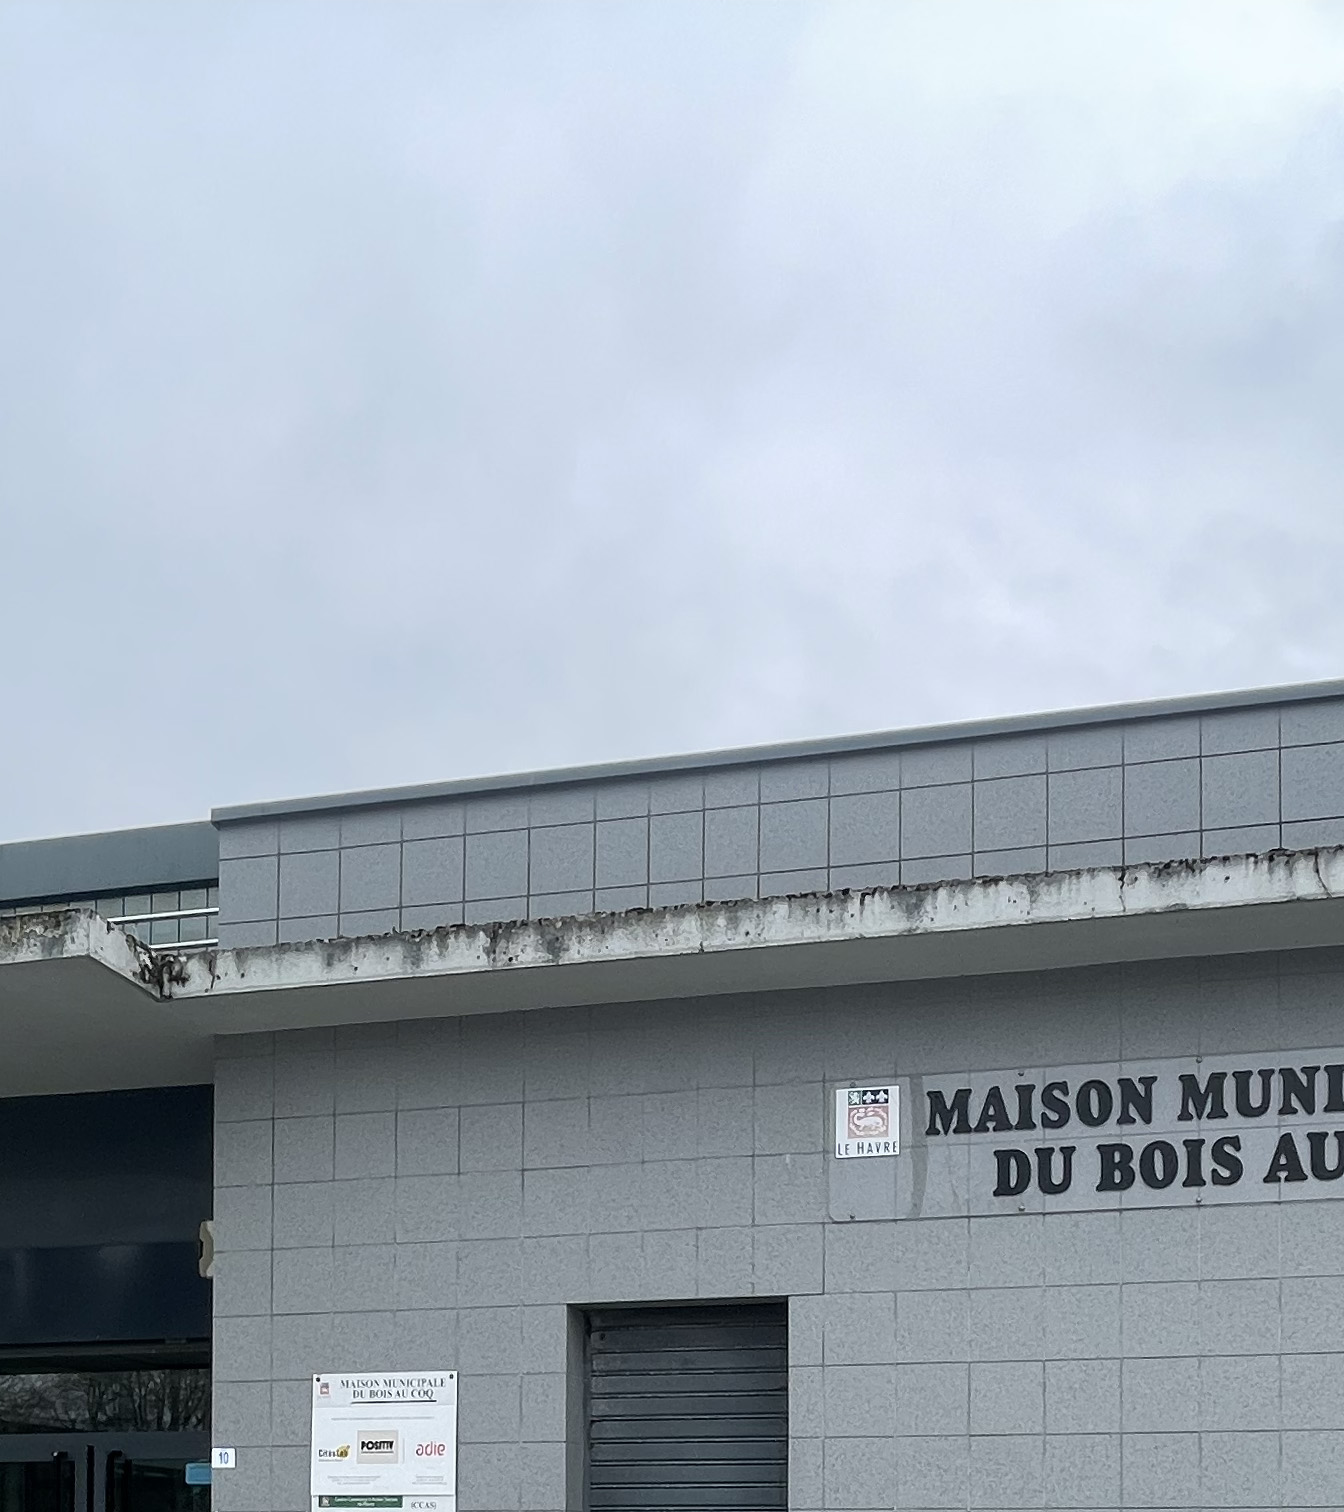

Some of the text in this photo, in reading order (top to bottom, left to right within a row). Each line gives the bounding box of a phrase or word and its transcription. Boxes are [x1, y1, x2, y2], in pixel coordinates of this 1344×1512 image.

[925, 1076, 1158, 1136] MAISON
[837, 1141, 898, 1156] LE HAVRE
[993, 1145, 1076, 1197] DU
[1095, 1135, 1244, 1192] BOIS
[340, 1378, 446, 1389] MAISON MUNICIPALE
[353, 1388, 434, 1399] DU BOIS AU COQ
[361, 1440, 394, 1450] POSITIV
[415, 1441, 446, 1456] adie
[218, 1451, 229, 1465] 10
